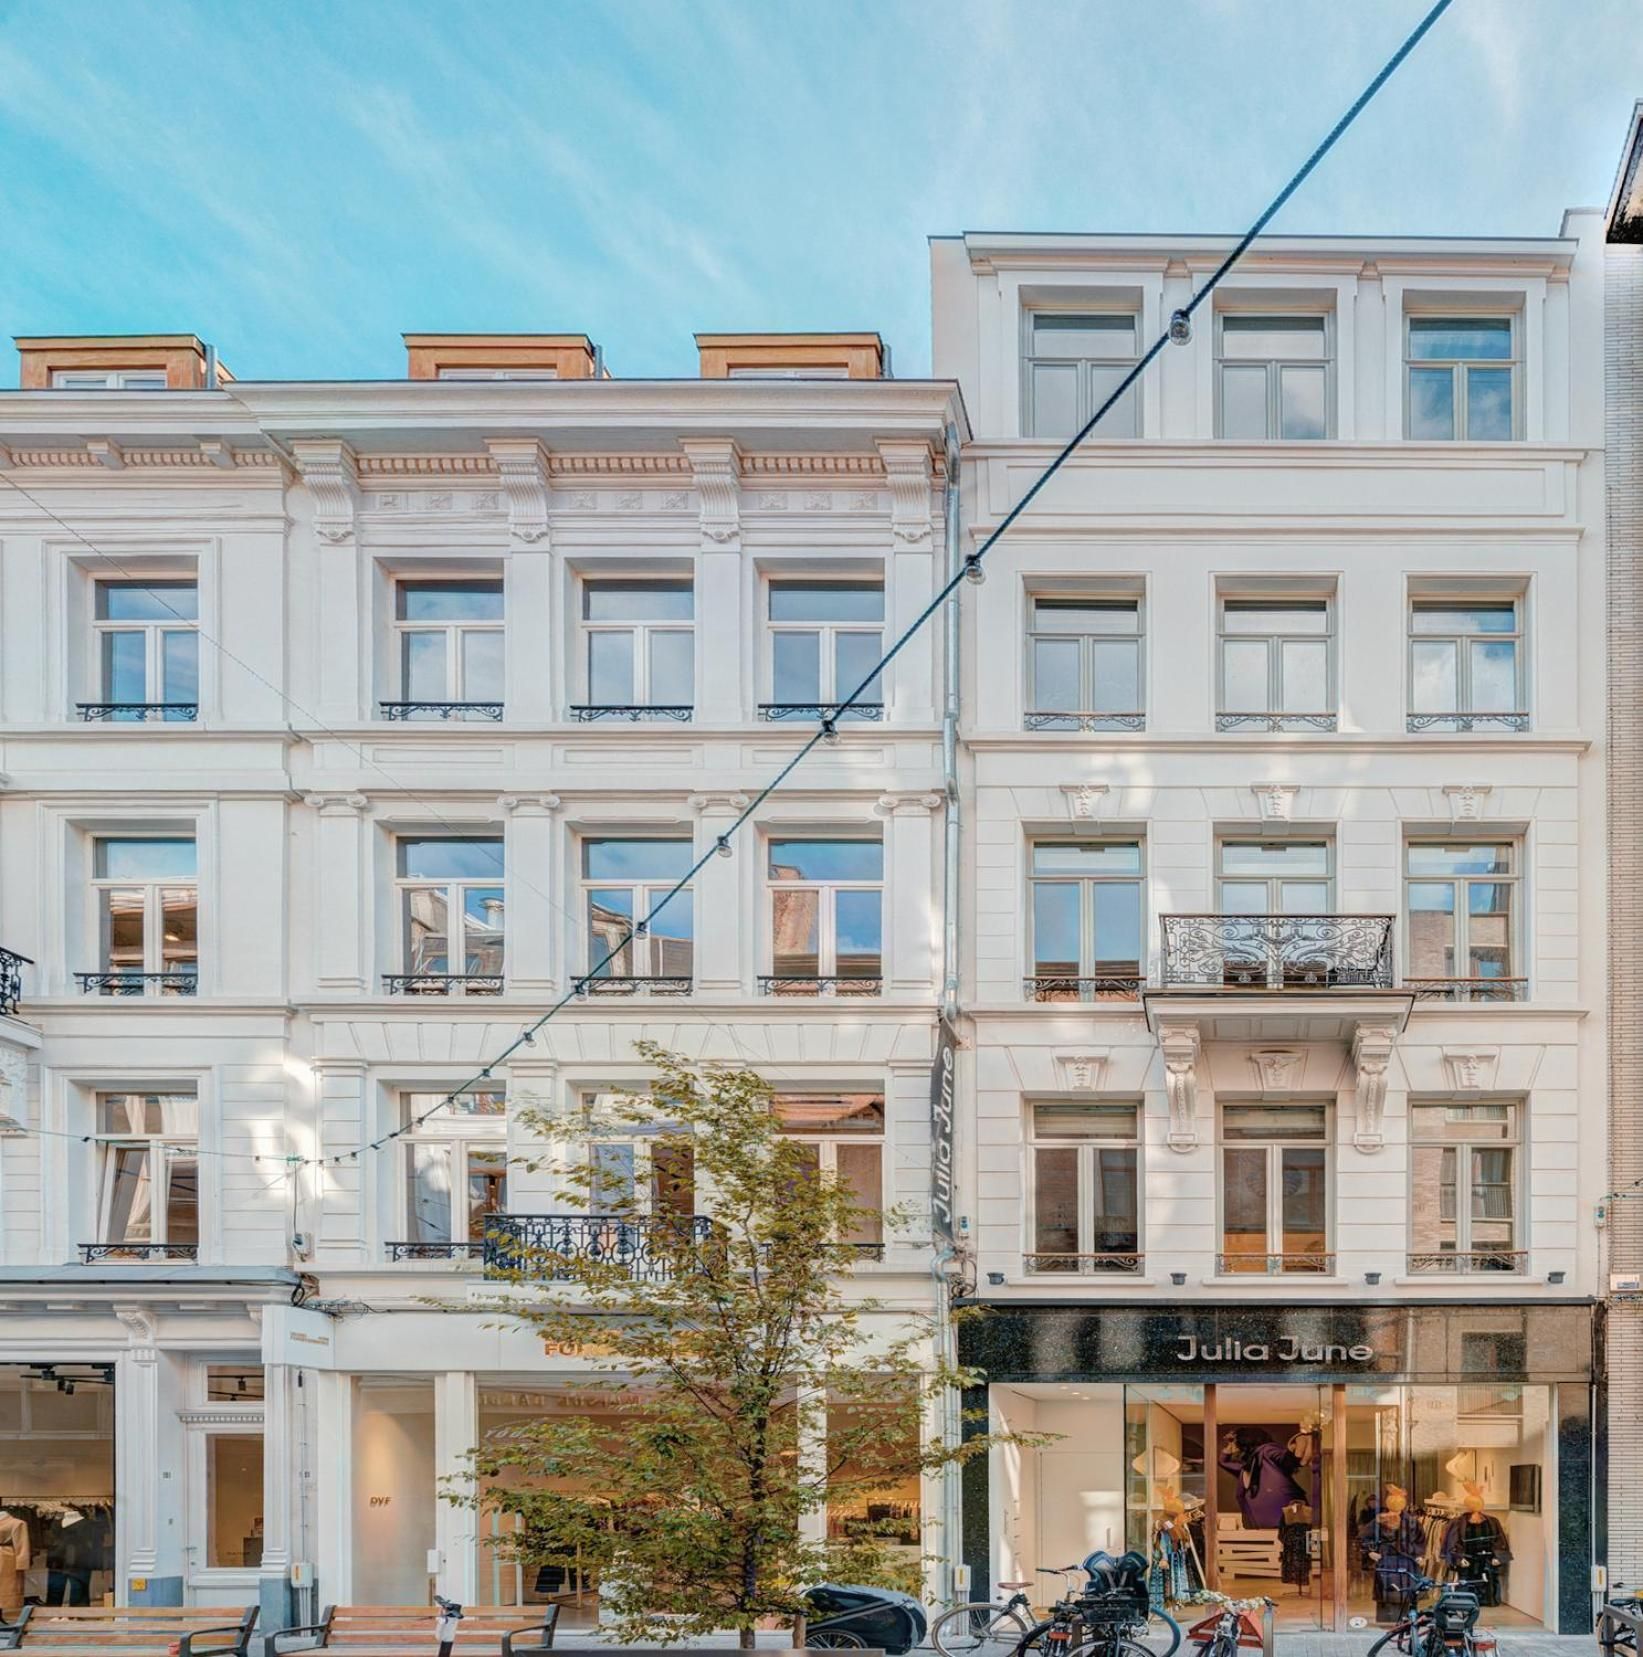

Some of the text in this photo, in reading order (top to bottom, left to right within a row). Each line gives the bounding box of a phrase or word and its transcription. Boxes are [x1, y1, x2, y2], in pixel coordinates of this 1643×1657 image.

[933, 1046, 953, 1223] Julia June
[1177, 1335, 1374, 1362] Julia June
